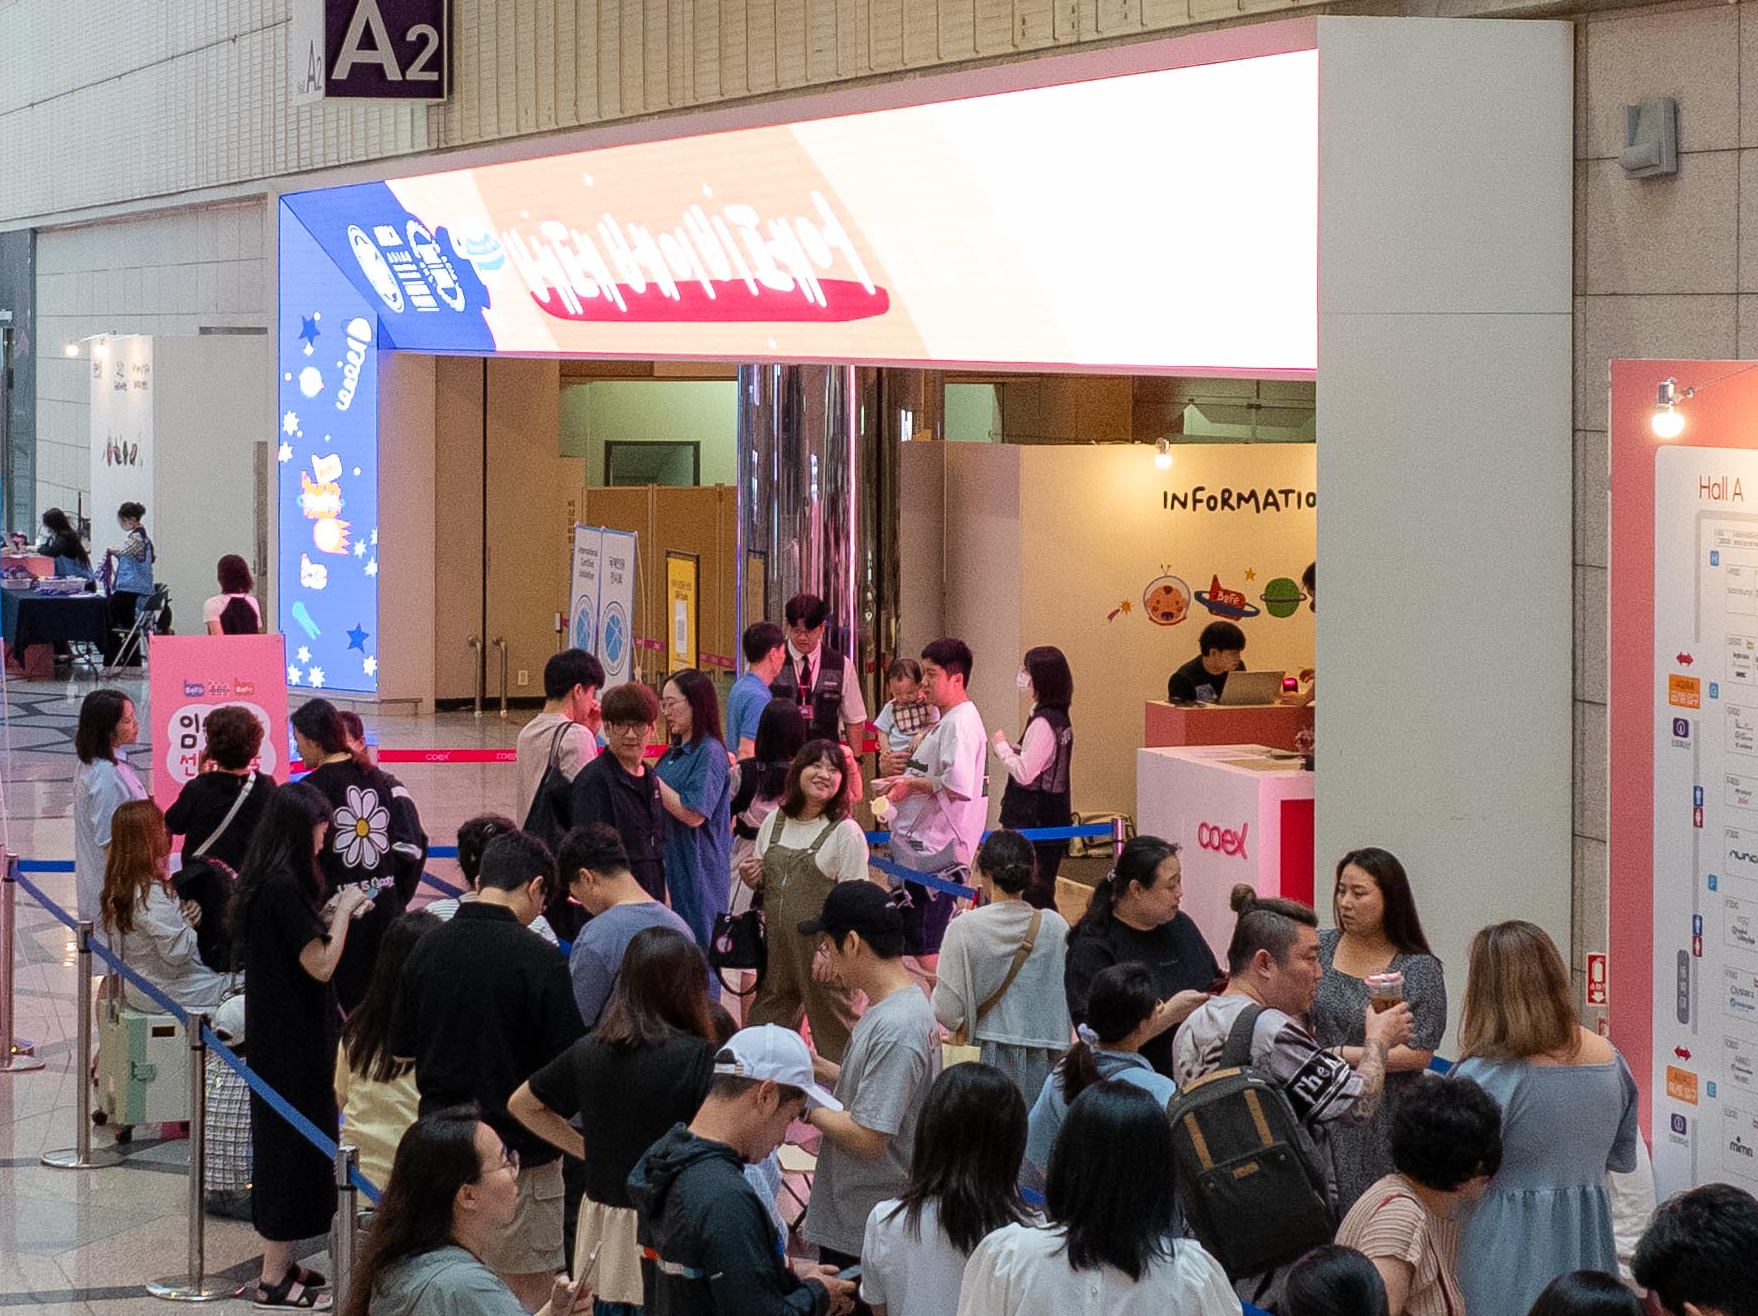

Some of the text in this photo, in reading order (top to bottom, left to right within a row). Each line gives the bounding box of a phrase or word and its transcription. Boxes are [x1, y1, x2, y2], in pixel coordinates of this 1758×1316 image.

[1699, 476, 1744, 502] Hall A
[1217, 589, 1240, 606] BeFe
[425, 751, 450, 761] coex
[1198, 821, 1249, 860] coex
[1729, 849, 1758, 865] nuna
